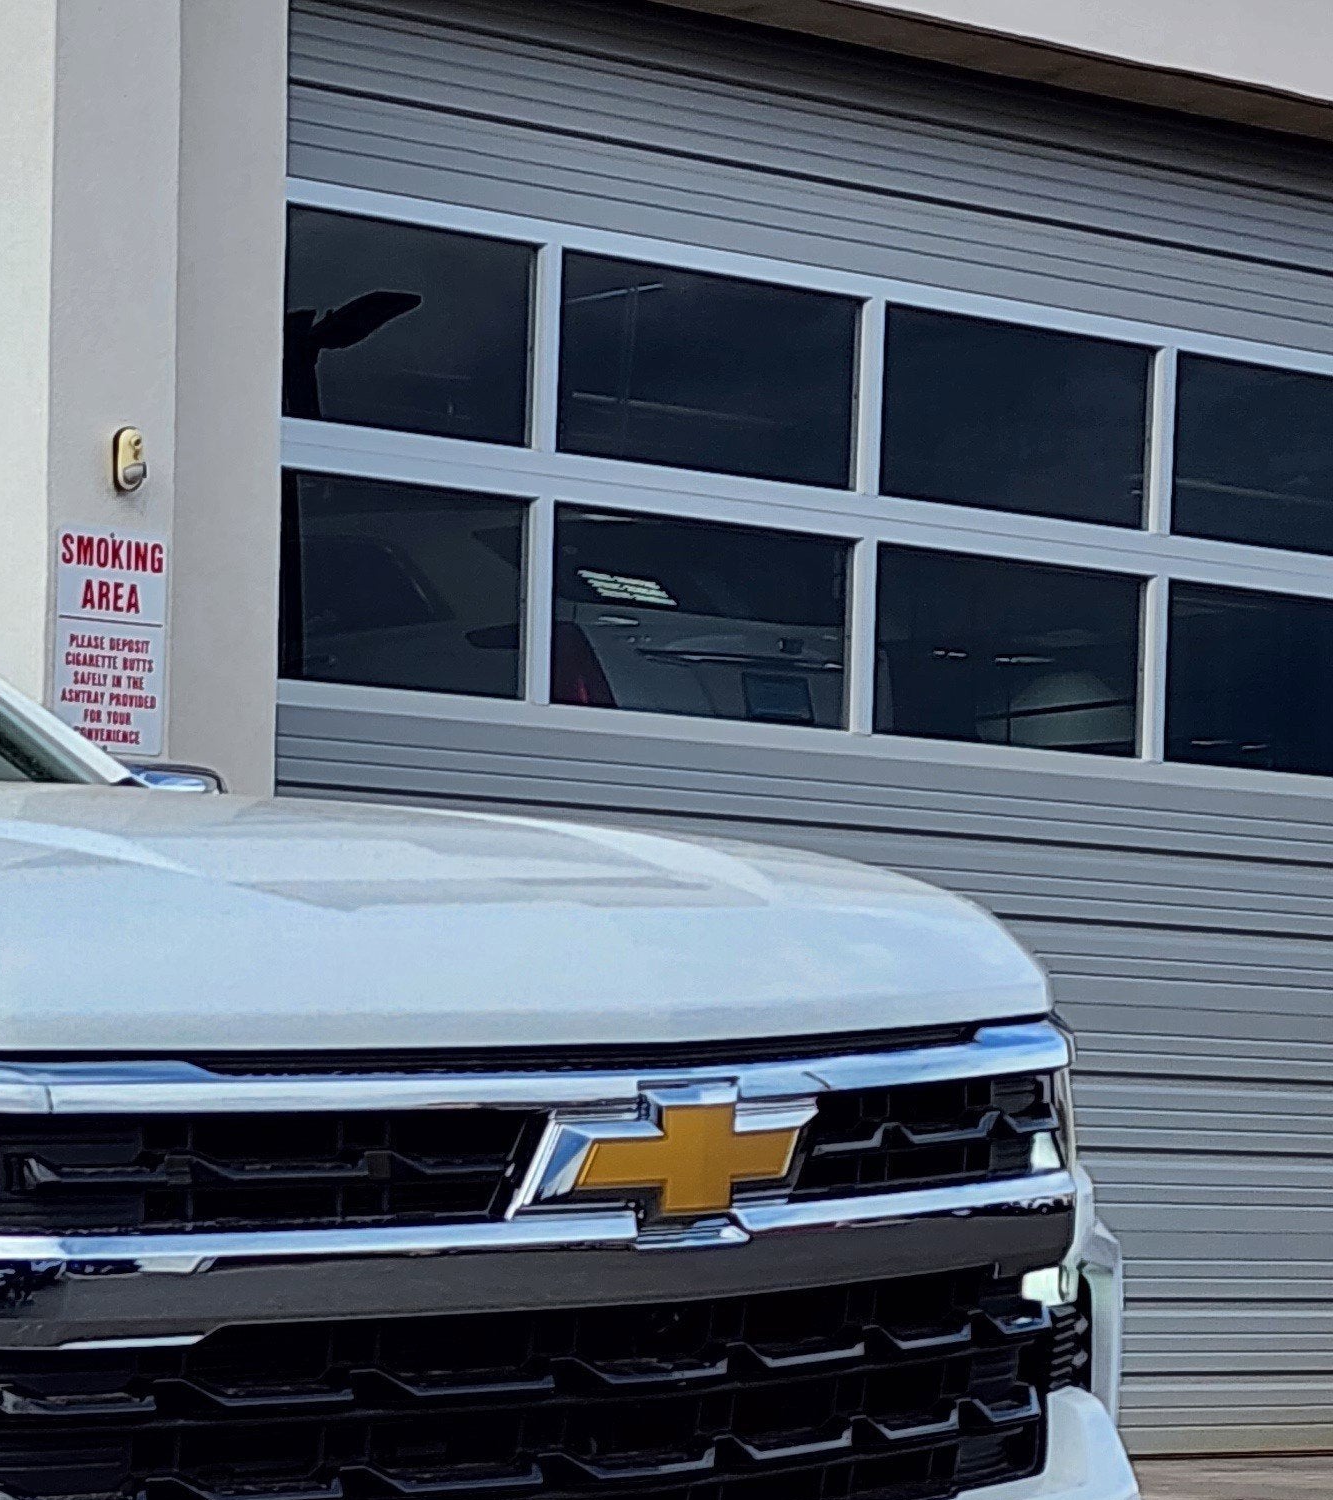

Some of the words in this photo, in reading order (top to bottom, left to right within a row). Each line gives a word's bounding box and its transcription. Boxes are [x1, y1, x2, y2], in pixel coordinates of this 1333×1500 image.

[61, 533, 164, 573] SMOKING
[81, 579, 140, 614] AREA
[69, 633, 105, 650] PLEASE
[109, 637, 150, 654] DEPOSIT
[65, 651, 118, 670] CIGARETTE
[122, 656, 154, 673] BUTTS
[73, 670, 108, 687] SAFELY
[111, 675, 123, 688] IN
[126, 675, 145, 691] THE
[60, 687, 106, 705] ASHTRAY
[108, 692, 157, 710] PROVIDED
[83, 708, 102, 723] FOR
[106, 710, 132, 725] YOUR
